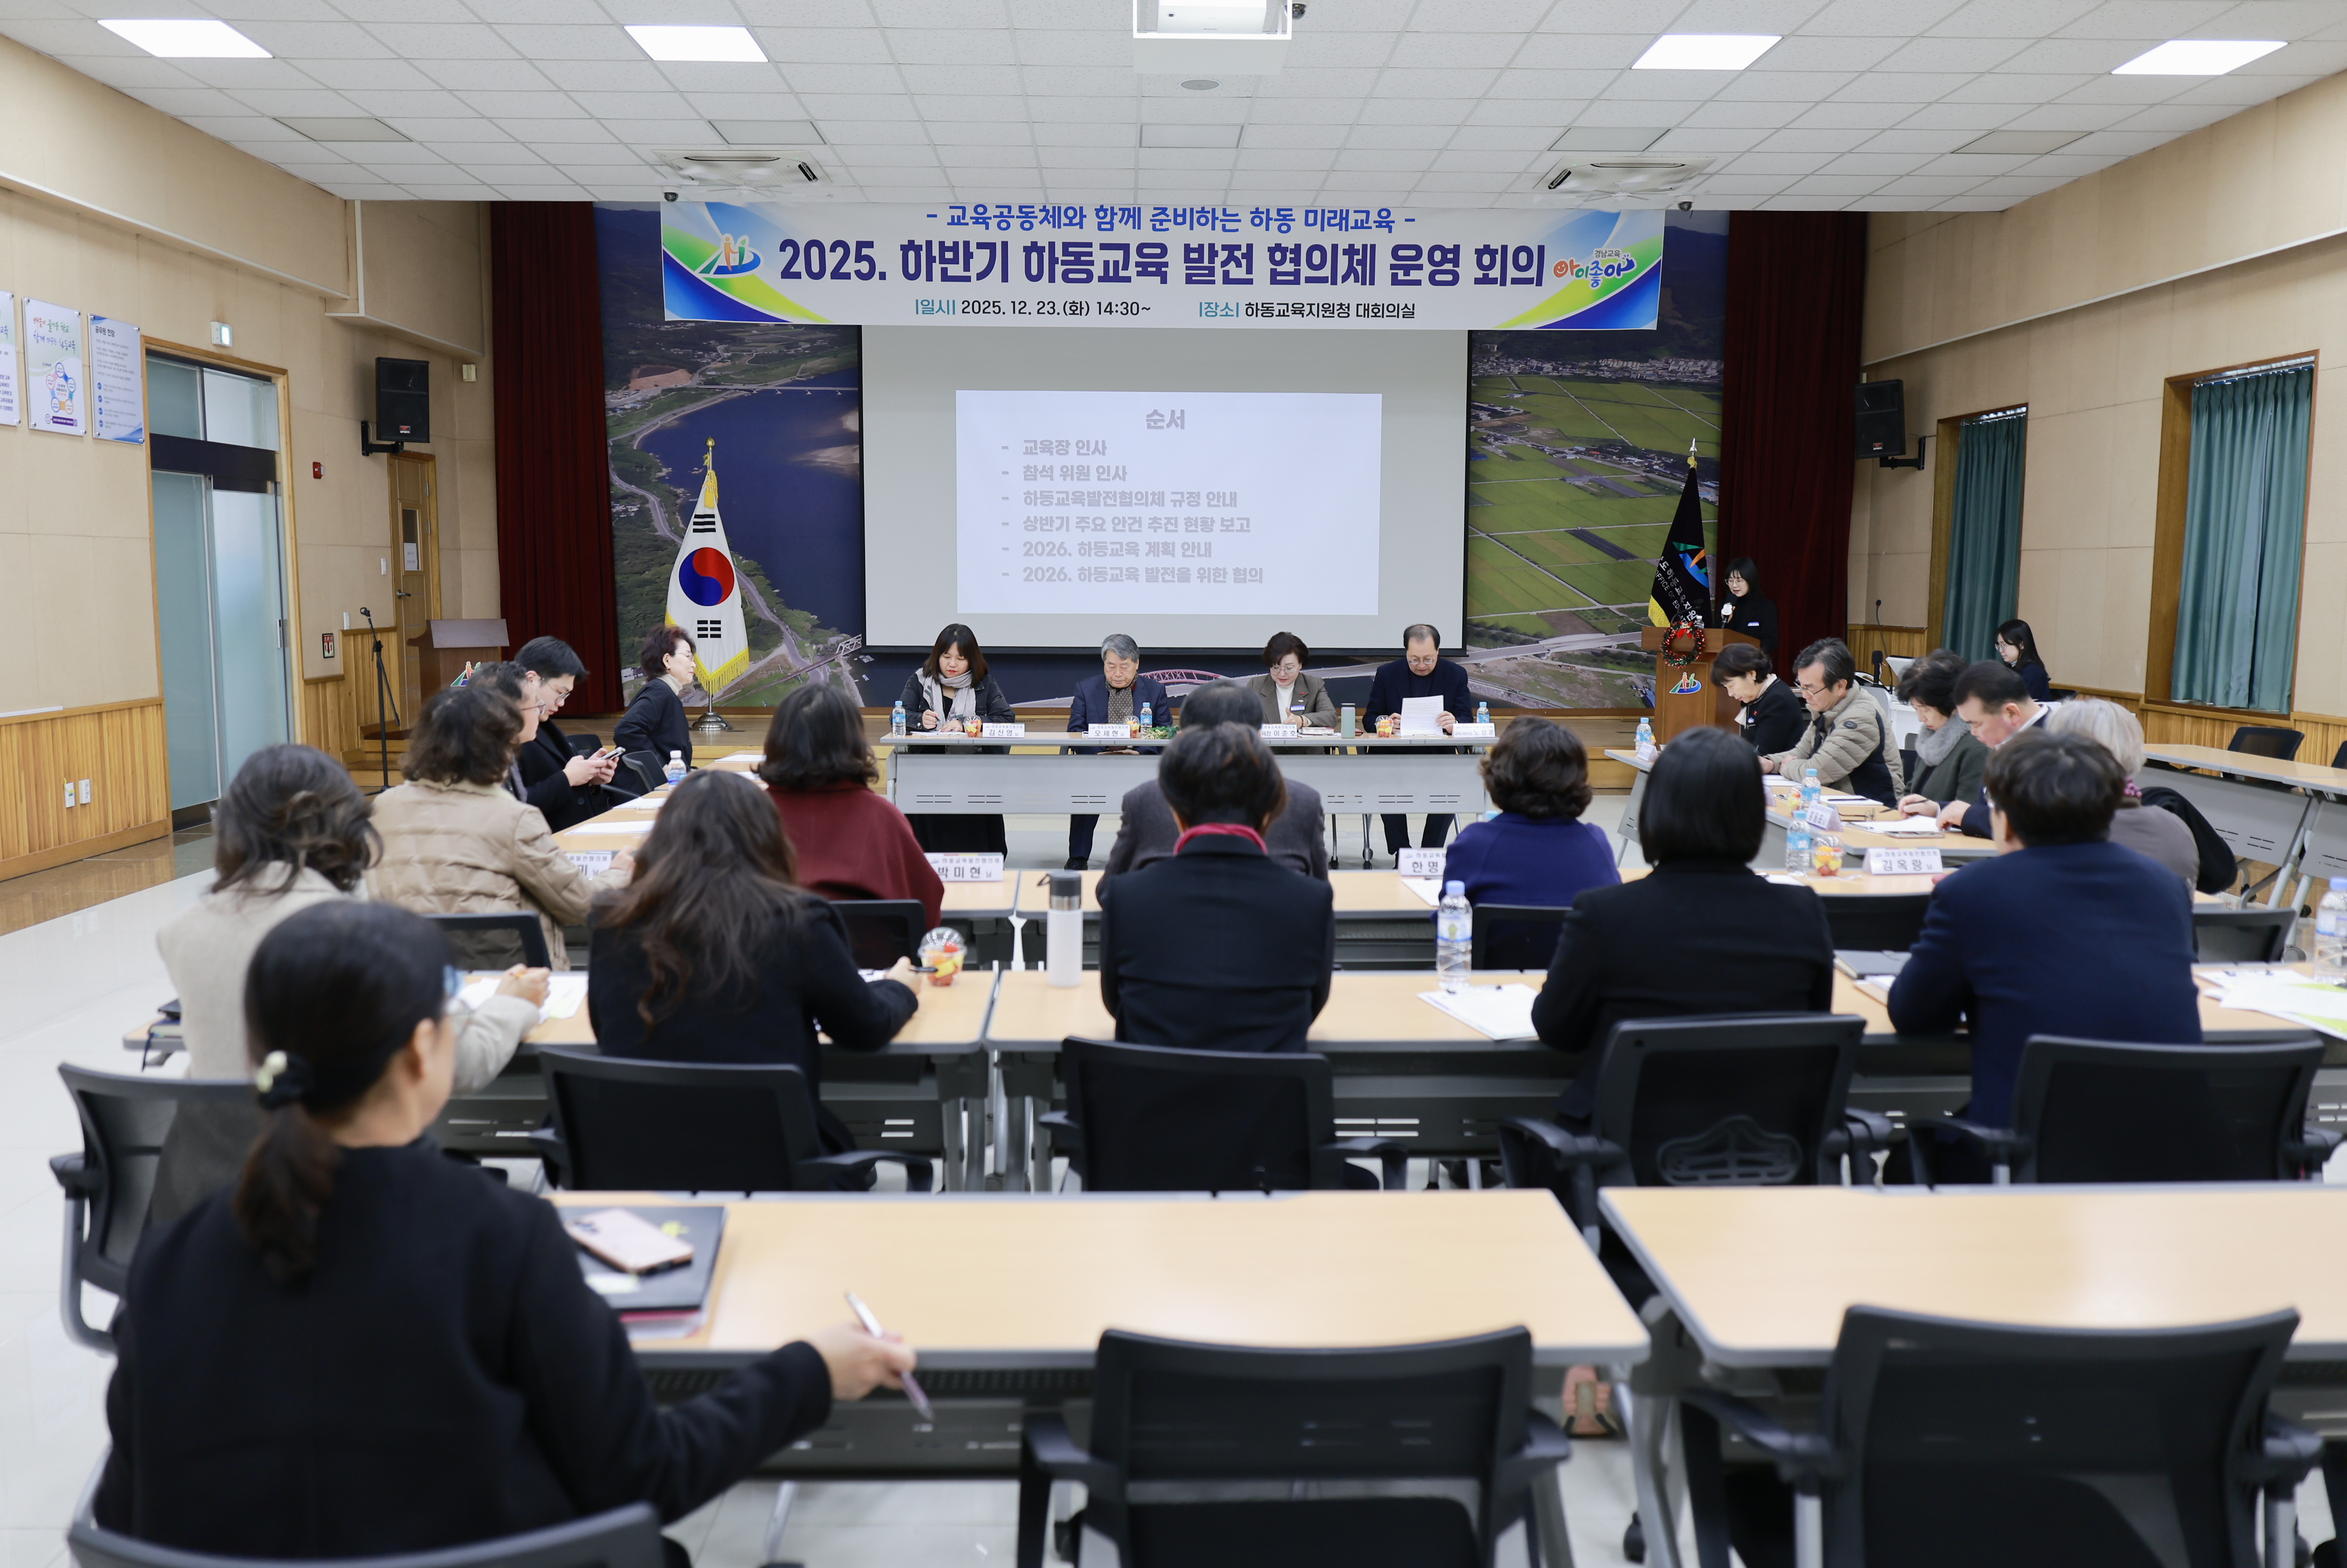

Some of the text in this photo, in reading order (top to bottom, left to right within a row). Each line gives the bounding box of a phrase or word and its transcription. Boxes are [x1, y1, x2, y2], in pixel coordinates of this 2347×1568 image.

[947, 204, 1395, 234] 교육공동체와 함께 준비하는 하동 미래교육
[779, 238, 1546, 287] 2025. 하반기 하동교육 발전 협의체 운영 회의
[1594, 249, 1621, 258] 경남교육
[1553, 258, 1635, 288] 아이좋아
[961, 300, 1006, 315] 2025.
[1011, 300, 1032, 316] 12.
[1096, 301, 1151, 316] 14:30~
[1245, 303, 1351, 318] 하동교육지원청
[1355, 303, 1416, 320] 대회의실
[95, 326, 115, 337] 공무원 헌장
[1145, 409, 1185, 430] 순서
[1022, 439, 1107, 457] 교육장 인사
[1022, 464, 1128, 482] 참석 위원 인사
[1023, 490, 1238, 508] 하동교육발전협의체 규정 안내
[1022, 516, 1251, 534] 상반기 주요 안건 추진 현황 보고
[1023, 541, 1212, 559] 2026. 하동교육 계획 안내
[1023, 566, 1263, 585] 2026. 하동교육 발전을 위한 협의
[938, 866, 981, 879] 박미현
[1412, 860, 1438, 873] 한명
[1883, 859, 1922, 872] 김옥랑
